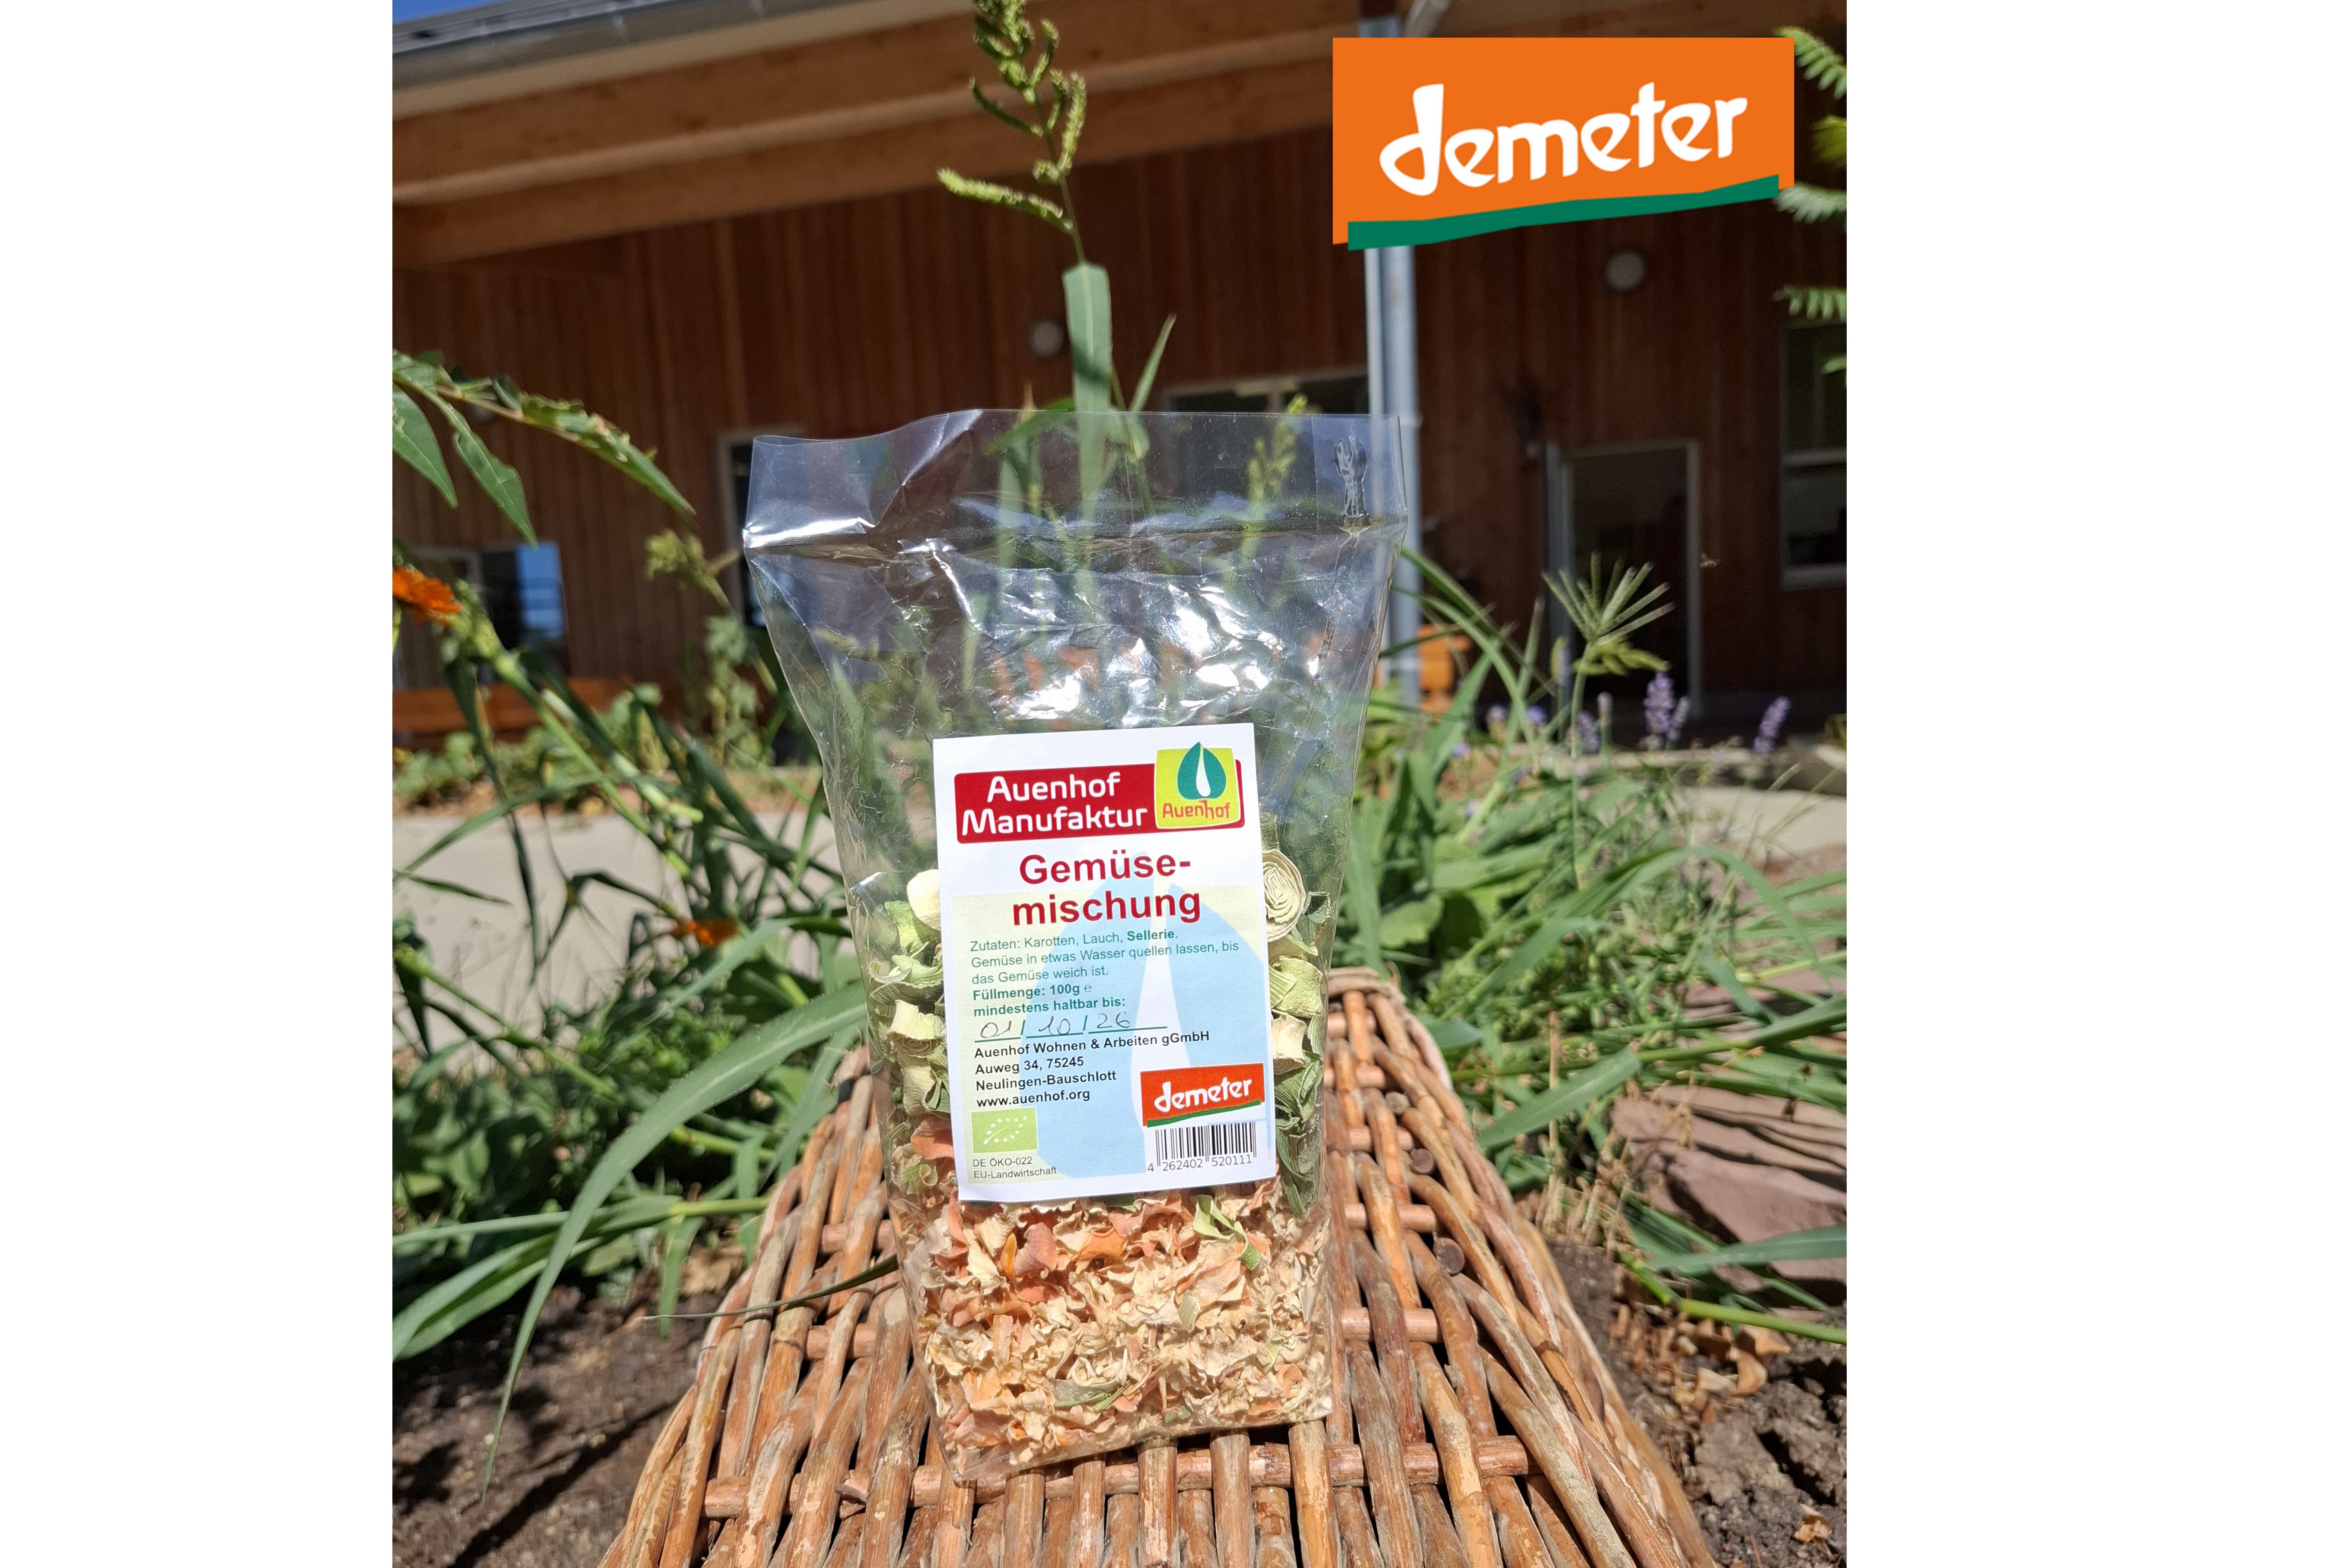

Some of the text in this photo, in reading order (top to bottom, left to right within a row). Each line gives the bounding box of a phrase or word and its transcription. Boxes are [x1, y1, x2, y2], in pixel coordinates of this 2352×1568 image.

[987, 771, 1121, 803] Auenhof
[962, 805, 1148, 836] Manufaktur
[1162, 800, 1230, 820] Auenhof
[1020, 849, 1191, 884] Gemüse-
[1013, 890, 1201, 926] mischung
[970, 929, 1178, 951] Zutaten: Karotten, Lauch, Sellerie.
[971, 941, 1239, 967] Gemüse in etwas Wasser quellen lassen, bis
[972, 965, 1109, 984] das Gemüse weich ist.
[973, 987, 1045, 1000] Füllmenge:
[1050, 984, 1080, 996] 100g
[974, 996, 1125, 1017] mindestens haltbar bis:
[974, 1031, 1209, 1058] Auenhof Wohnen & Arbeiten gGmbH
[975, 1056, 1084, 1075] Auweg 34, 75245
[976, 1070, 1116, 1091] Neulingen-Bauschlott
[976, 1090, 1090, 1107] www.auenhof.org
[1154, 1076, 1252, 1112] demeter
[974, 1166, 1057, 1178] EU-Landwirtschaft
[989, 1156, 1033, 1167] ÖKO-022
[1147, 1154, 1252, 1172] 4 262402 520111
